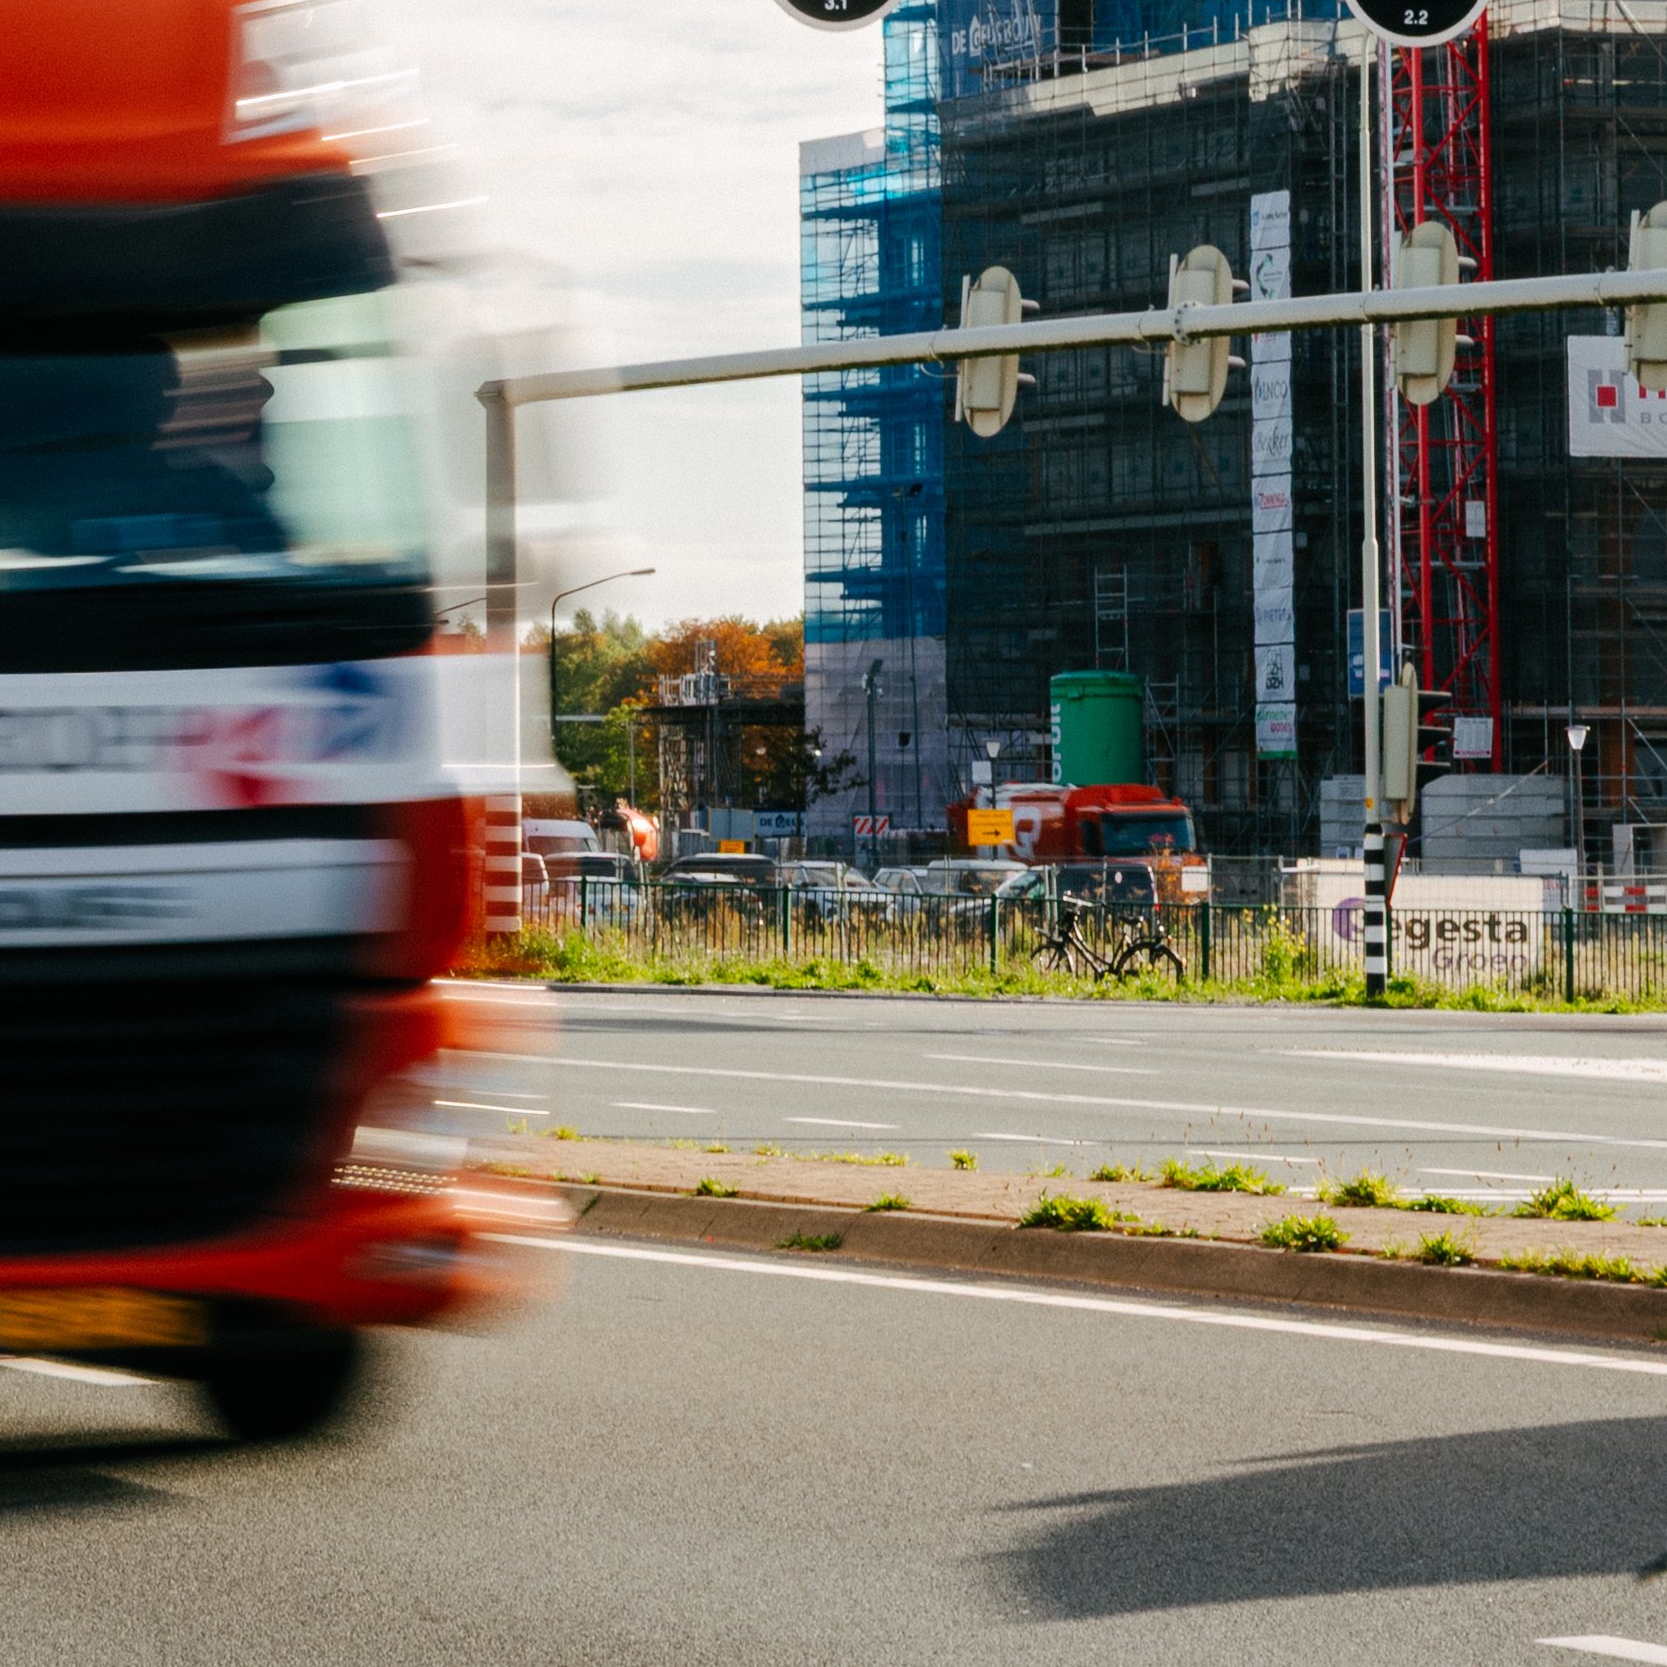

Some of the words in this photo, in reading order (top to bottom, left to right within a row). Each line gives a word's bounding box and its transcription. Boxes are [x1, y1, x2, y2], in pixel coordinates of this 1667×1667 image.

[1404, 8, 1429, 25] 2.2
[951, 29, 967, 55] DE
[1387, 913, 1528, 950] egesta
